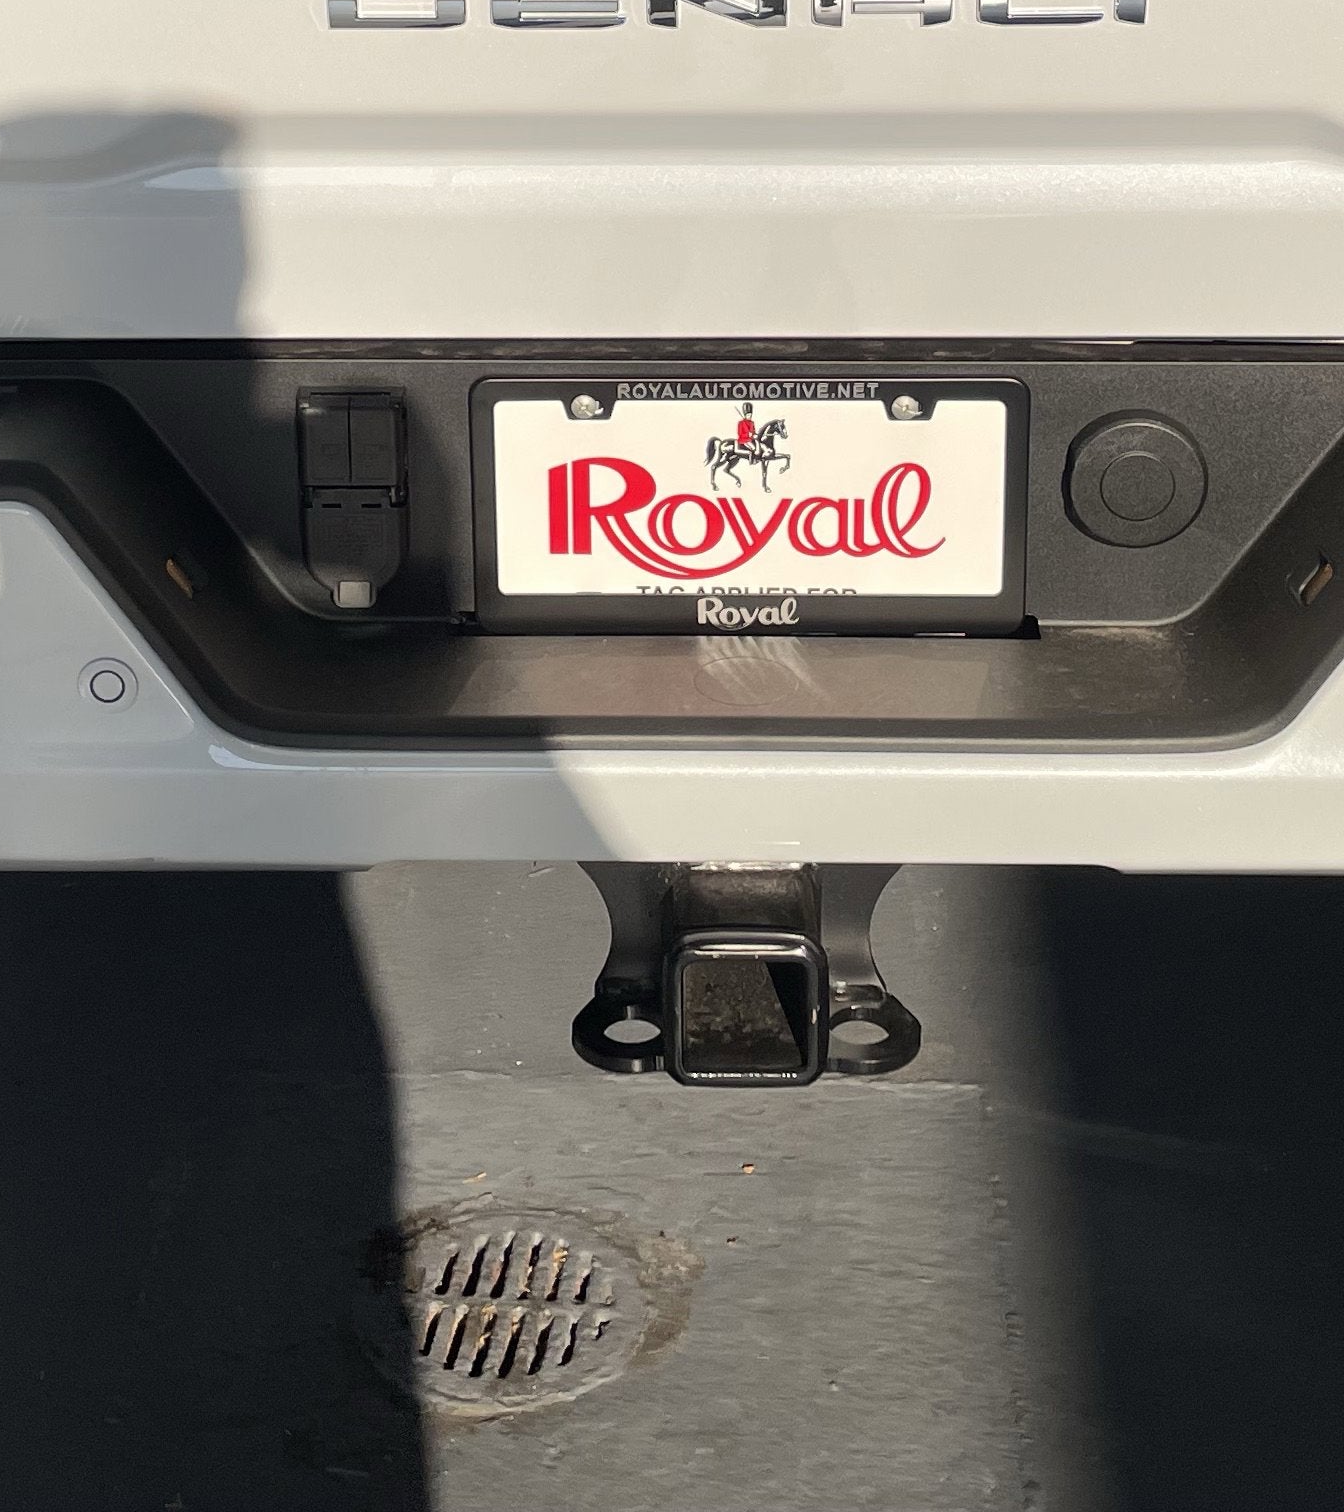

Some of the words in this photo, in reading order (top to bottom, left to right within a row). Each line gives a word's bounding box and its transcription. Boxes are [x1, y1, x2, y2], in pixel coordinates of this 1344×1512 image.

[616, 382, 880, 399] ROYALAUTOMOTIVE.NET
[548, 457, 946, 580] Royal
[697, 596, 800, 631] Royal
